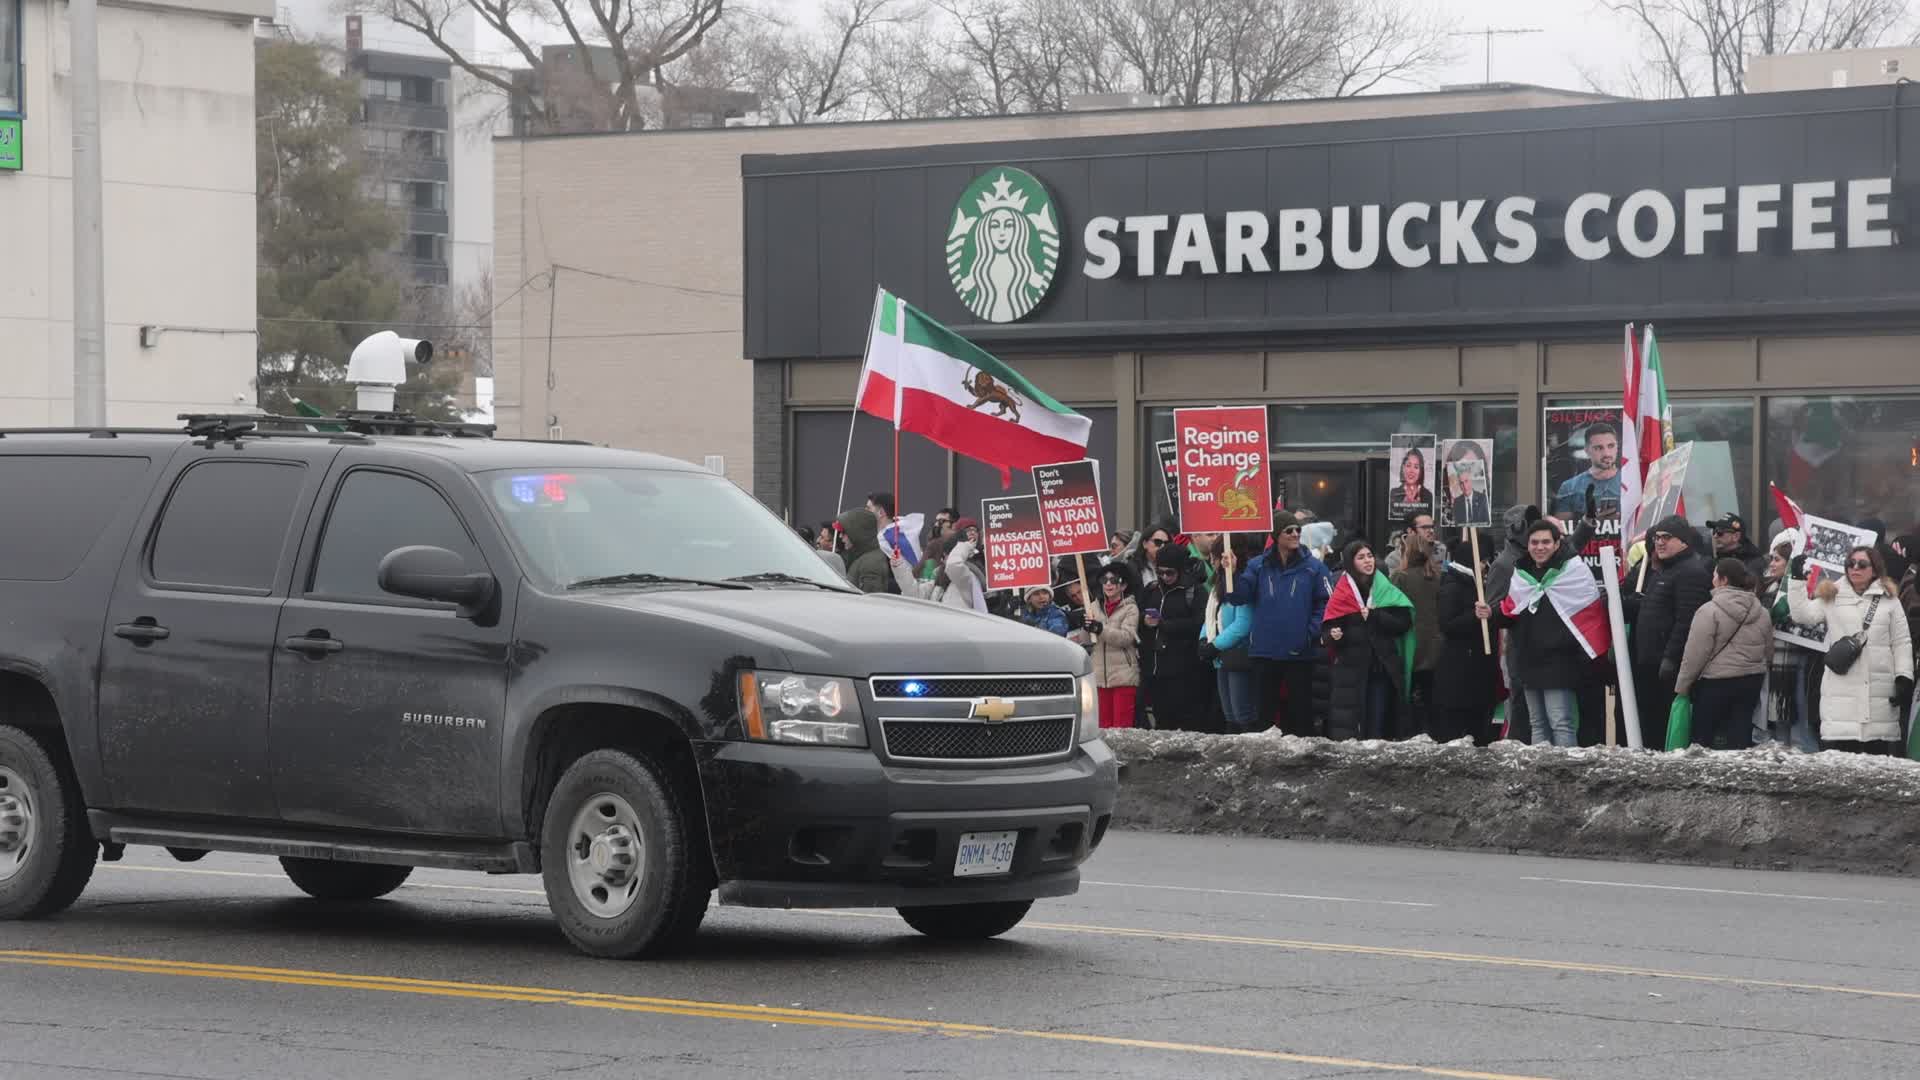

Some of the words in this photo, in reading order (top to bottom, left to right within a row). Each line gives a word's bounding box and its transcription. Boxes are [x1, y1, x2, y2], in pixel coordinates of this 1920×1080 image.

[1083, 196, 1537, 279] STARBUCKS
[1564, 178, 1892, 260] COFFEE
[1184, 426, 1259, 449] Regime
[1184, 448, 1260, 471] Change
[1040, 469, 1060, 478] Don't
[1041, 478, 1064, 488] ignore
[1187, 474, 1211, 487] For
[1188, 489, 1214, 502] Iran
[989, 503, 1009, 512] Don't
[1044, 496, 1095, 509] MASSACRE
[989, 512, 1013, 521] ignore
[1046, 510, 1062, 524] IN
[1064, 507, 1098, 522] IRAN
[990, 520, 1002, 528] the
[1050, 521, 1099, 538] +43,000
[990, 530, 1042, 543] MASSACRE
[1053, 538, 1072, 547] Killed
[991, 544, 1006, 557] IN
[1009, 541, 1043, 557] IRAN
[992, 556, 1044, 572] +43,000
[994, 572, 1014, 581] Killed
[402, 712, 486, 728] SUBURBAN
